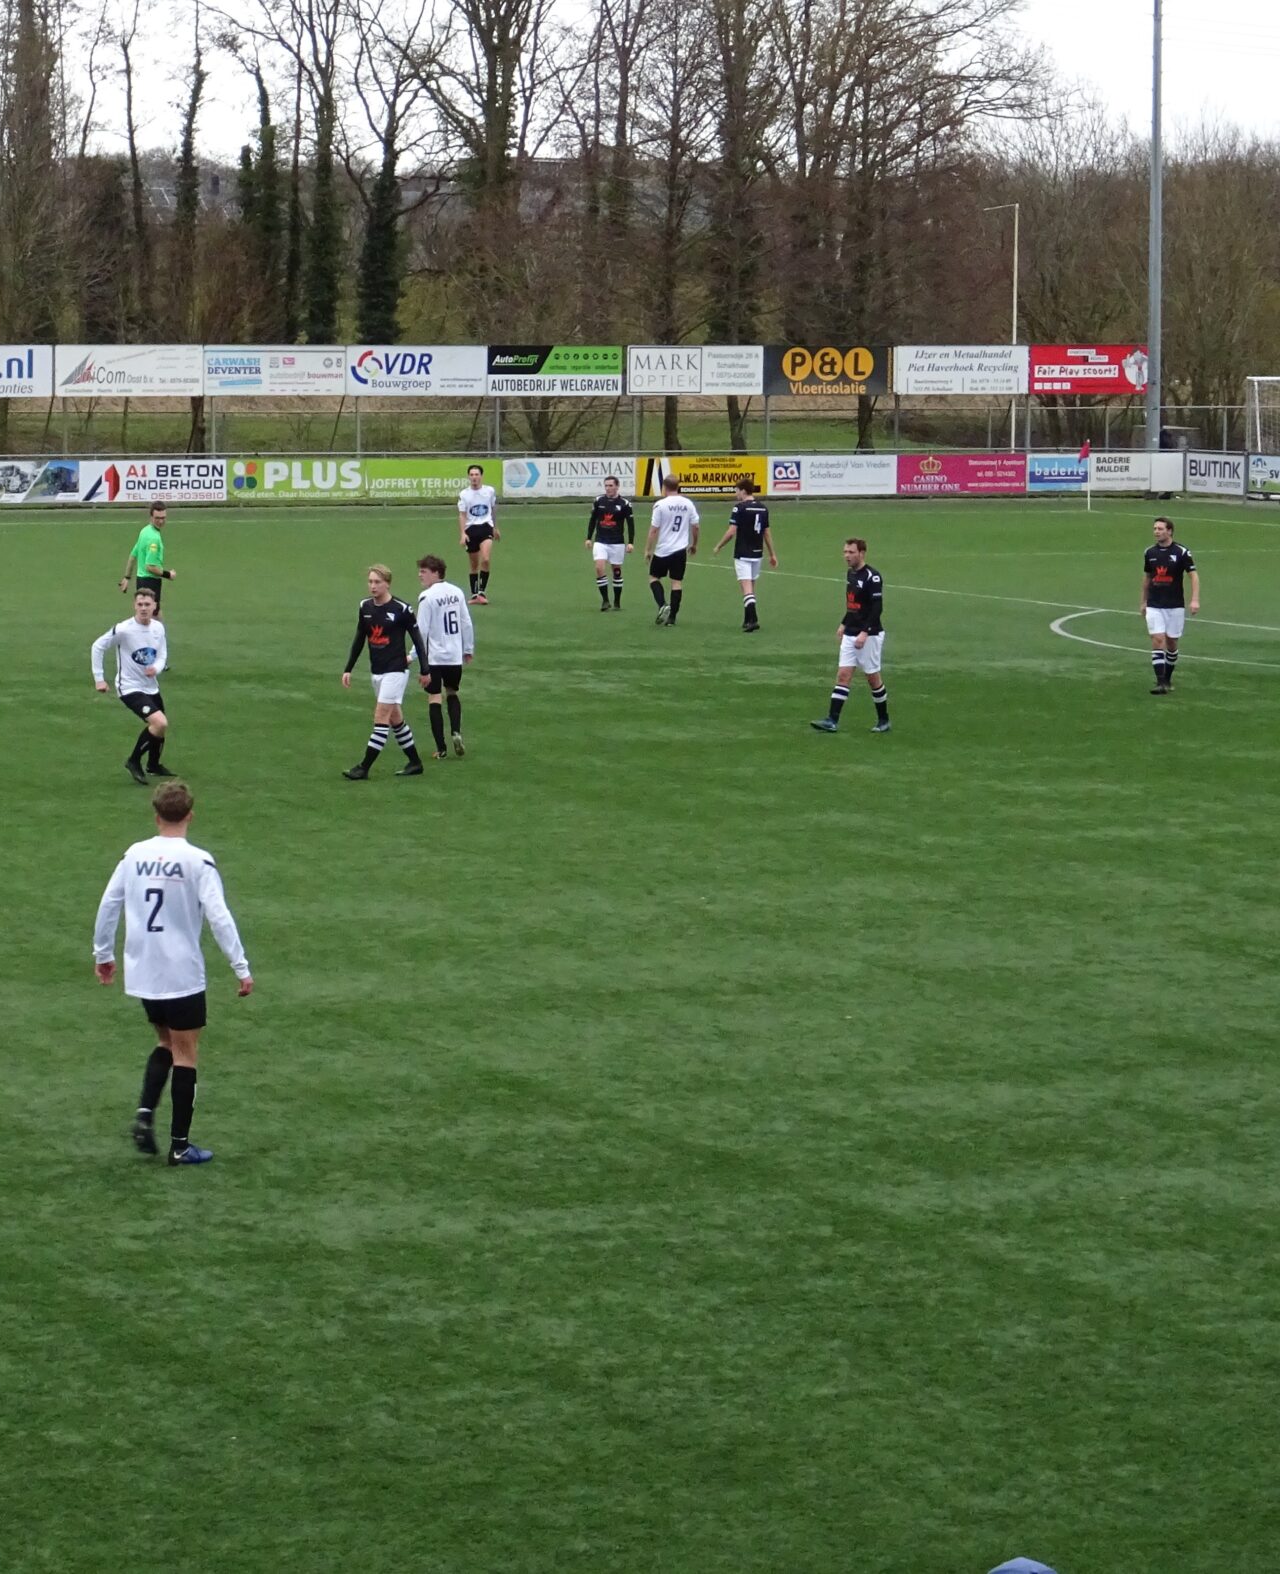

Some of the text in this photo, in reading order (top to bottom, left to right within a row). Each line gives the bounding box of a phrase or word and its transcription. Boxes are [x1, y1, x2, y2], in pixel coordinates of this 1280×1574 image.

[952, 350, 1012, 359] Metaalhandel
[207, 357, 260, 366] CARWASH
[384, 353, 433, 375] VDR
[634, 354, 698, 370] MARK
[207, 367, 261, 375] DEVENTER
[907, 363, 1019, 374] Piet Haverhoek Recycling
[1037, 366, 1056, 375] Fair
[1083, 367, 1117, 376] scoort!
[371, 379, 431, 391] Bouwgroep
[491, 379, 557, 391] AUTOBEDRIJF
[560, 379, 619, 391] WELGRAVEN
[633, 374, 698, 387] OPTIEK
[790, 382, 867, 394] Vloerisolatie
[809, 461, 891, 469] Autobedrijf Van Vreden
[1096, 456, 1131, 464] BADERIE
[126, 464, 224, 477] A1 BETON
[548, 462, 634, 475] HUNNEMAN
[1035, 462, 1085, 476] baderie
[1096, 465, 1130, 473] MULDER
[1189, 459, 1241, 479] BUITINK
[264, 461, 362, 489] PLUS
[913, 475, 948, 483] CASINO
[125, 480, 224, 490] ONDERHOUD
[371, 478, 470, 489] JOFFREY TER HOR
[900, 483, 961, 492] NUMBER ONE
[672, 515, 682, 532] 9
[754, 513, 762, 534] 4
[443, 611, 459, 635] 16
[144, 888, 164, 932] 2
